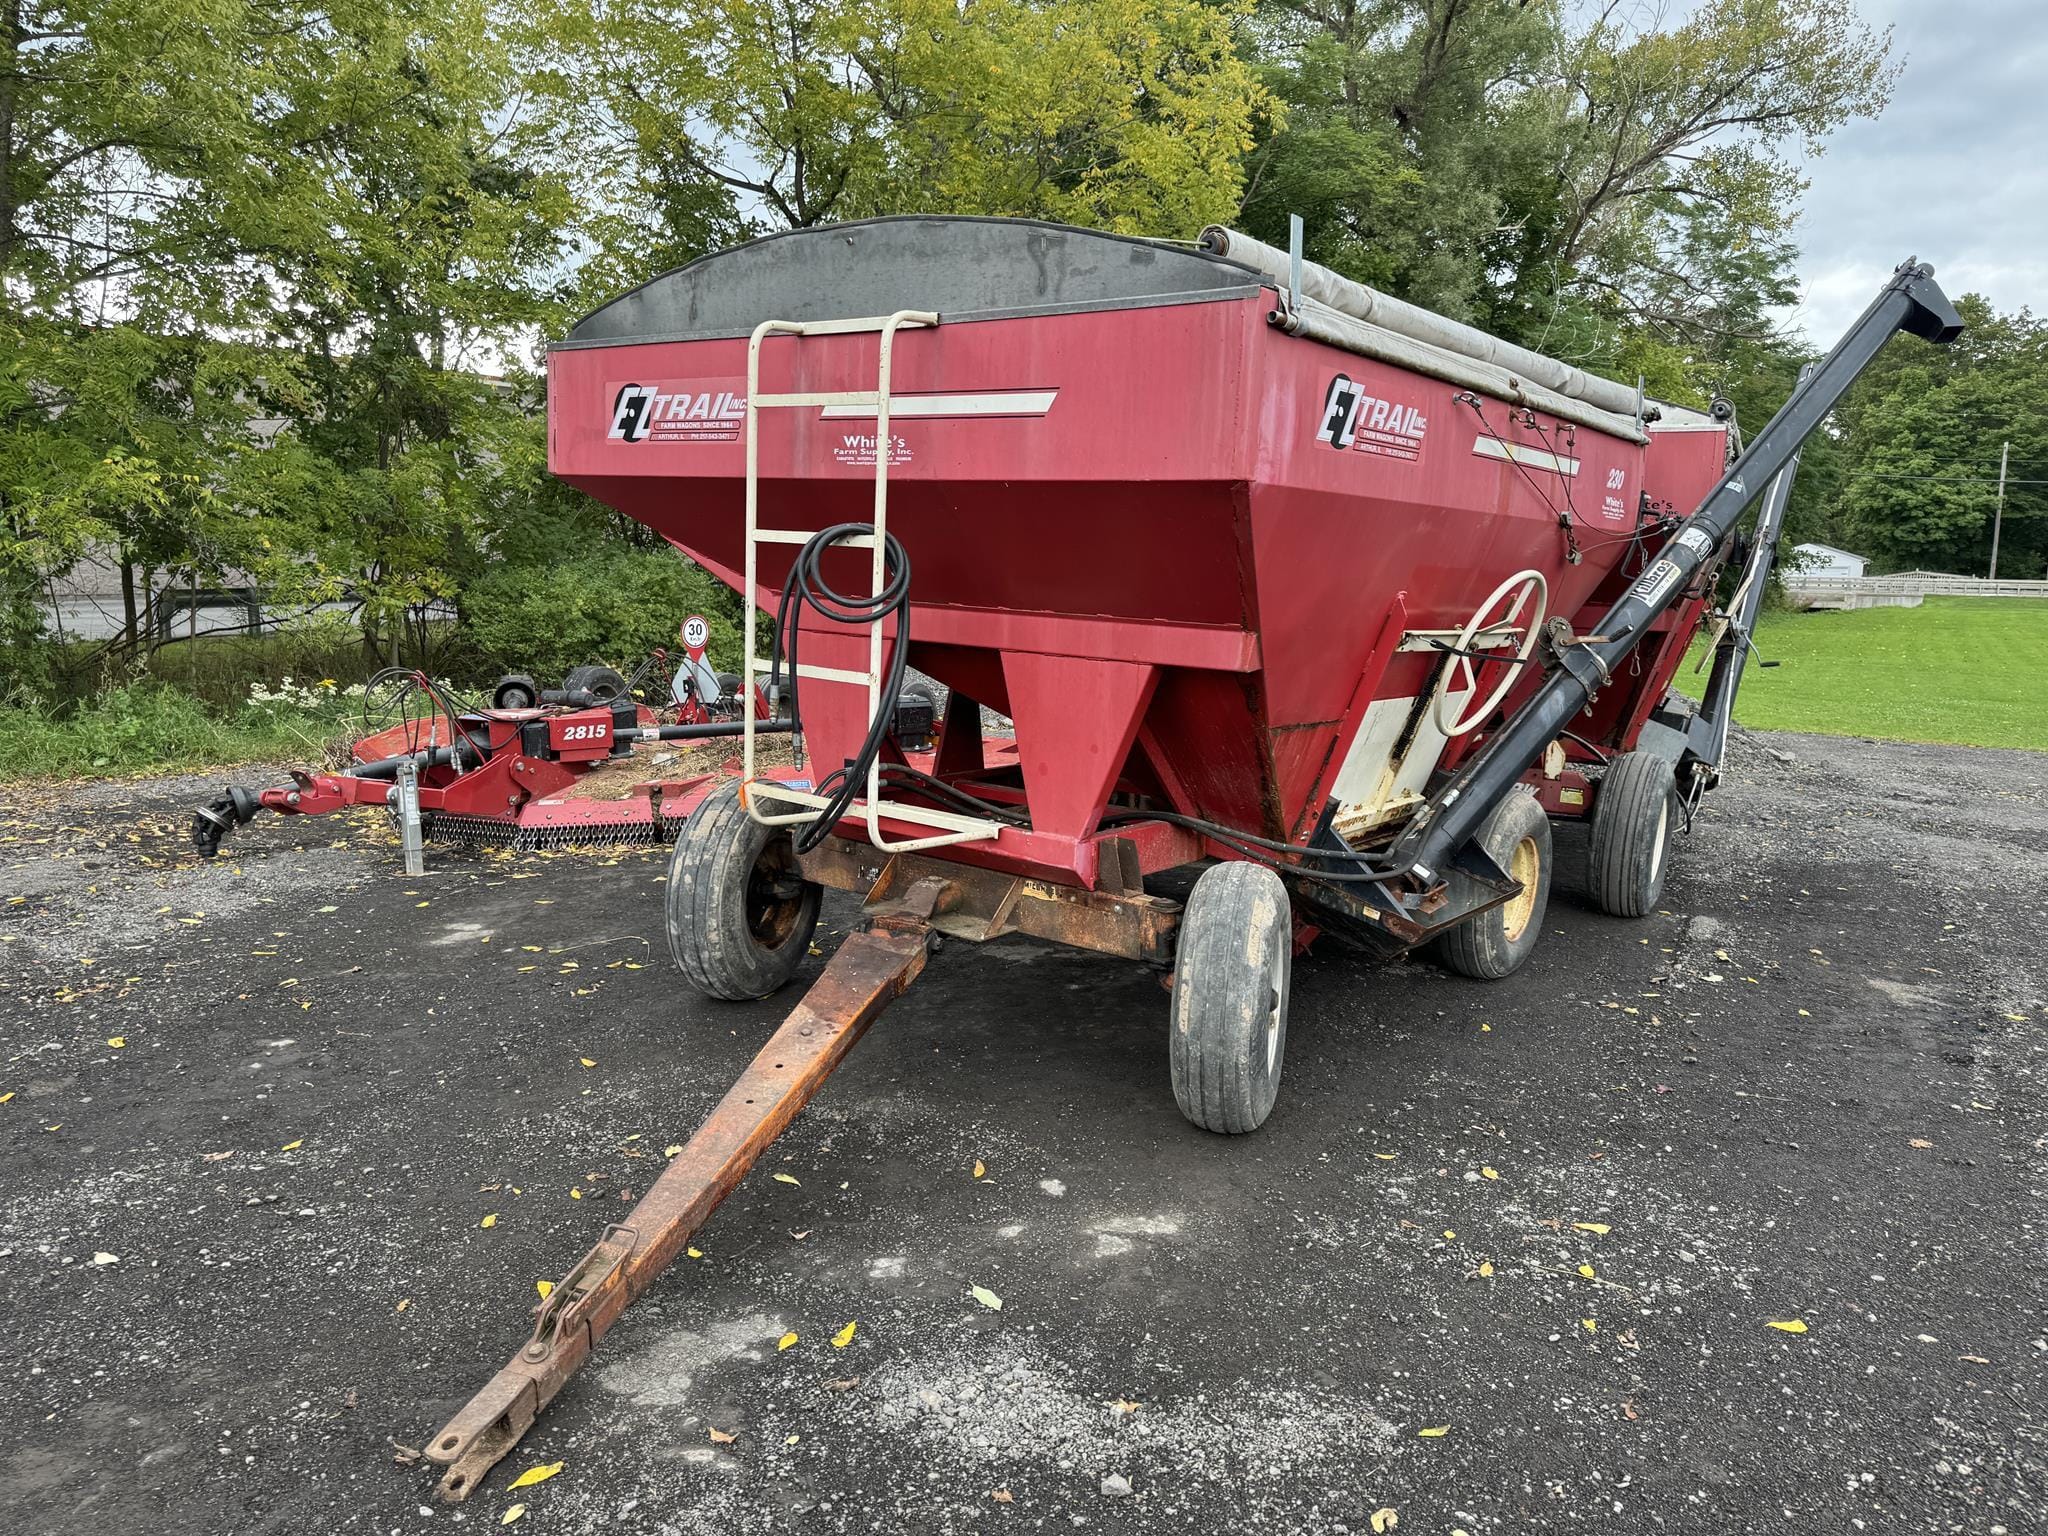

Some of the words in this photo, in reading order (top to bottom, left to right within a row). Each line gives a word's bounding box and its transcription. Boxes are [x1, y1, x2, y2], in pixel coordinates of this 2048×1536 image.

[653, 393, 746, 420] TRAIL
[1358, 395, 1424, 439] TRAIL
[843, 434, 906, 448] Whie's
[860, 448, 895, 457] Supy,
[1606, 468, 1625, 490] 230
[1629, 561, 1672, 601] Killbros
[688, 623, 703, 636] 30
[563, 724, 606, 741] 2815
